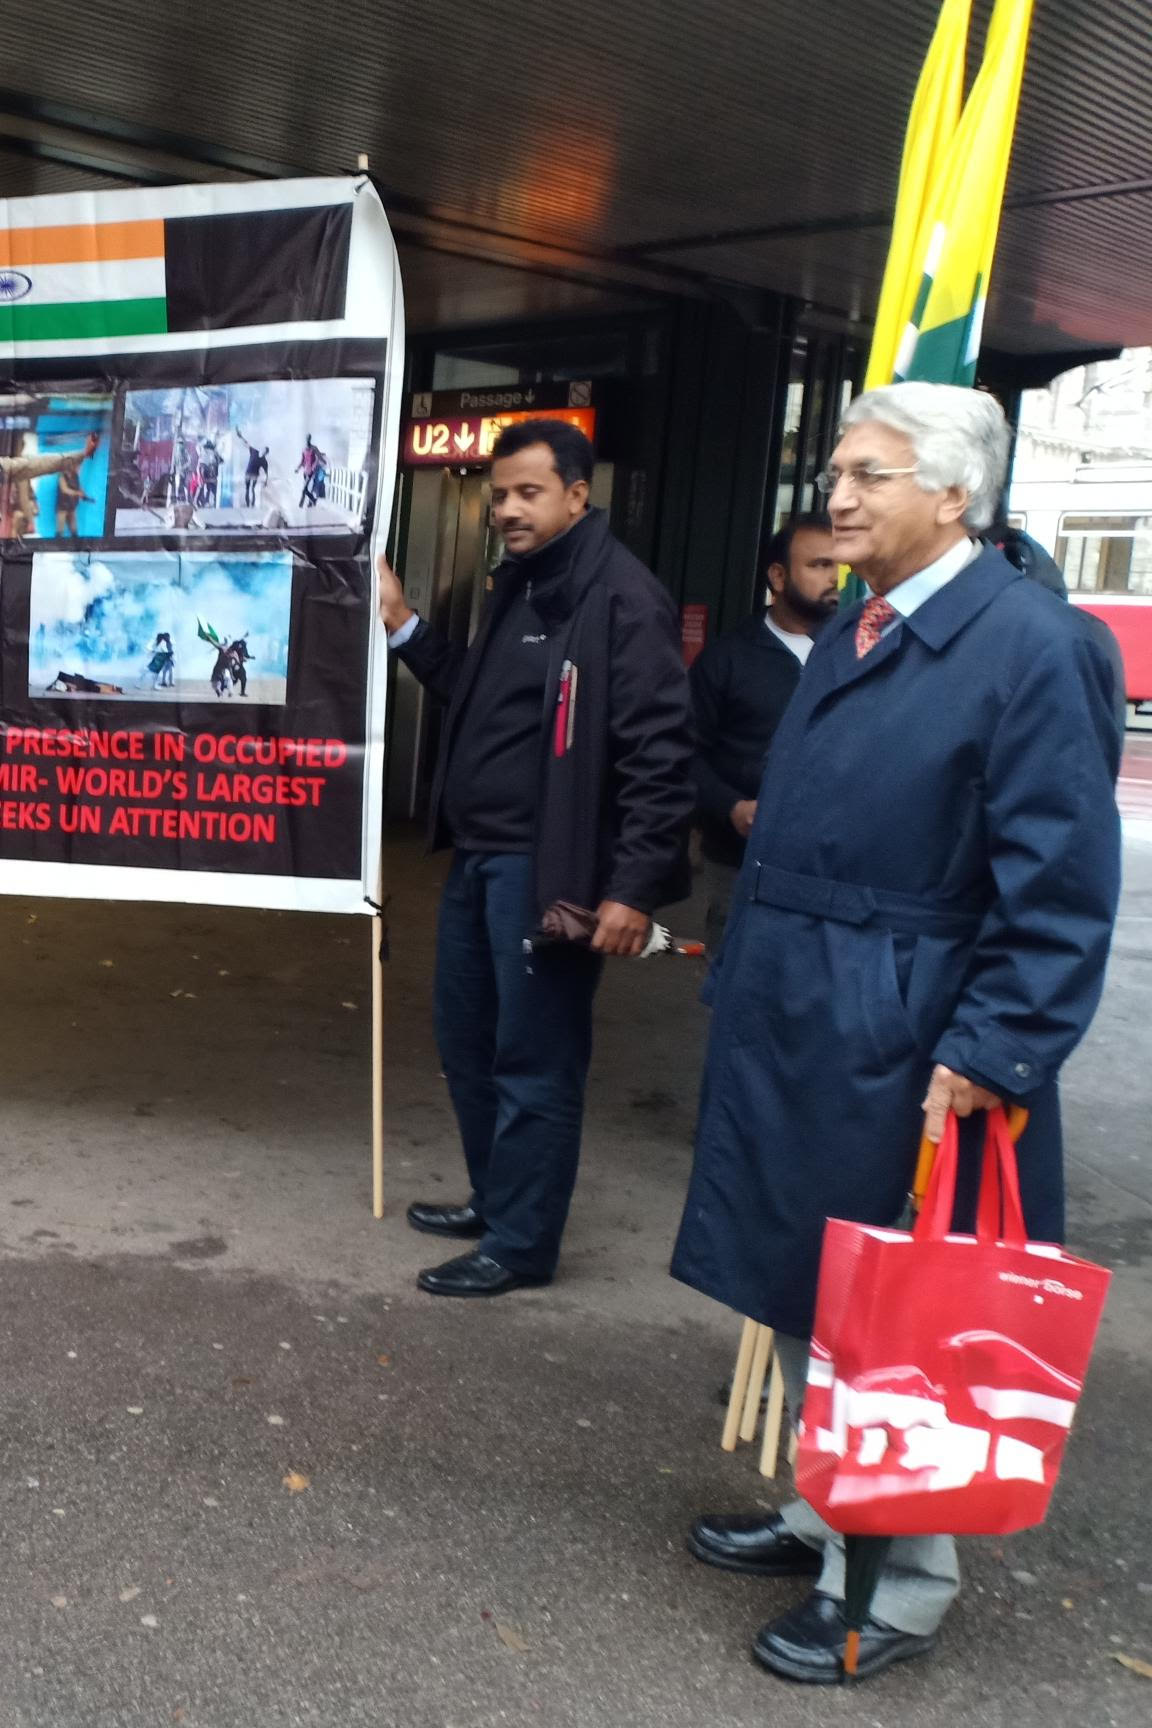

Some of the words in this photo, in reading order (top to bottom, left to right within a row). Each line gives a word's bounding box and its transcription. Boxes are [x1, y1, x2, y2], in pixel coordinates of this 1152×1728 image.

[461, 393, 522, 409] Passage
[412, 423, 450, 456] U2
[6, 726, 146, 760] PRESENCE
[153, 732, 186, 763] IN
[193, 732, 347, 768] OCCUPIED
[56, 766, 189, 801] WORLD’S
[196, 773, 328, 808] LARGEST
[58, 803, 104, 835] UN
[107, 806, 277, 844] ATTENTION
